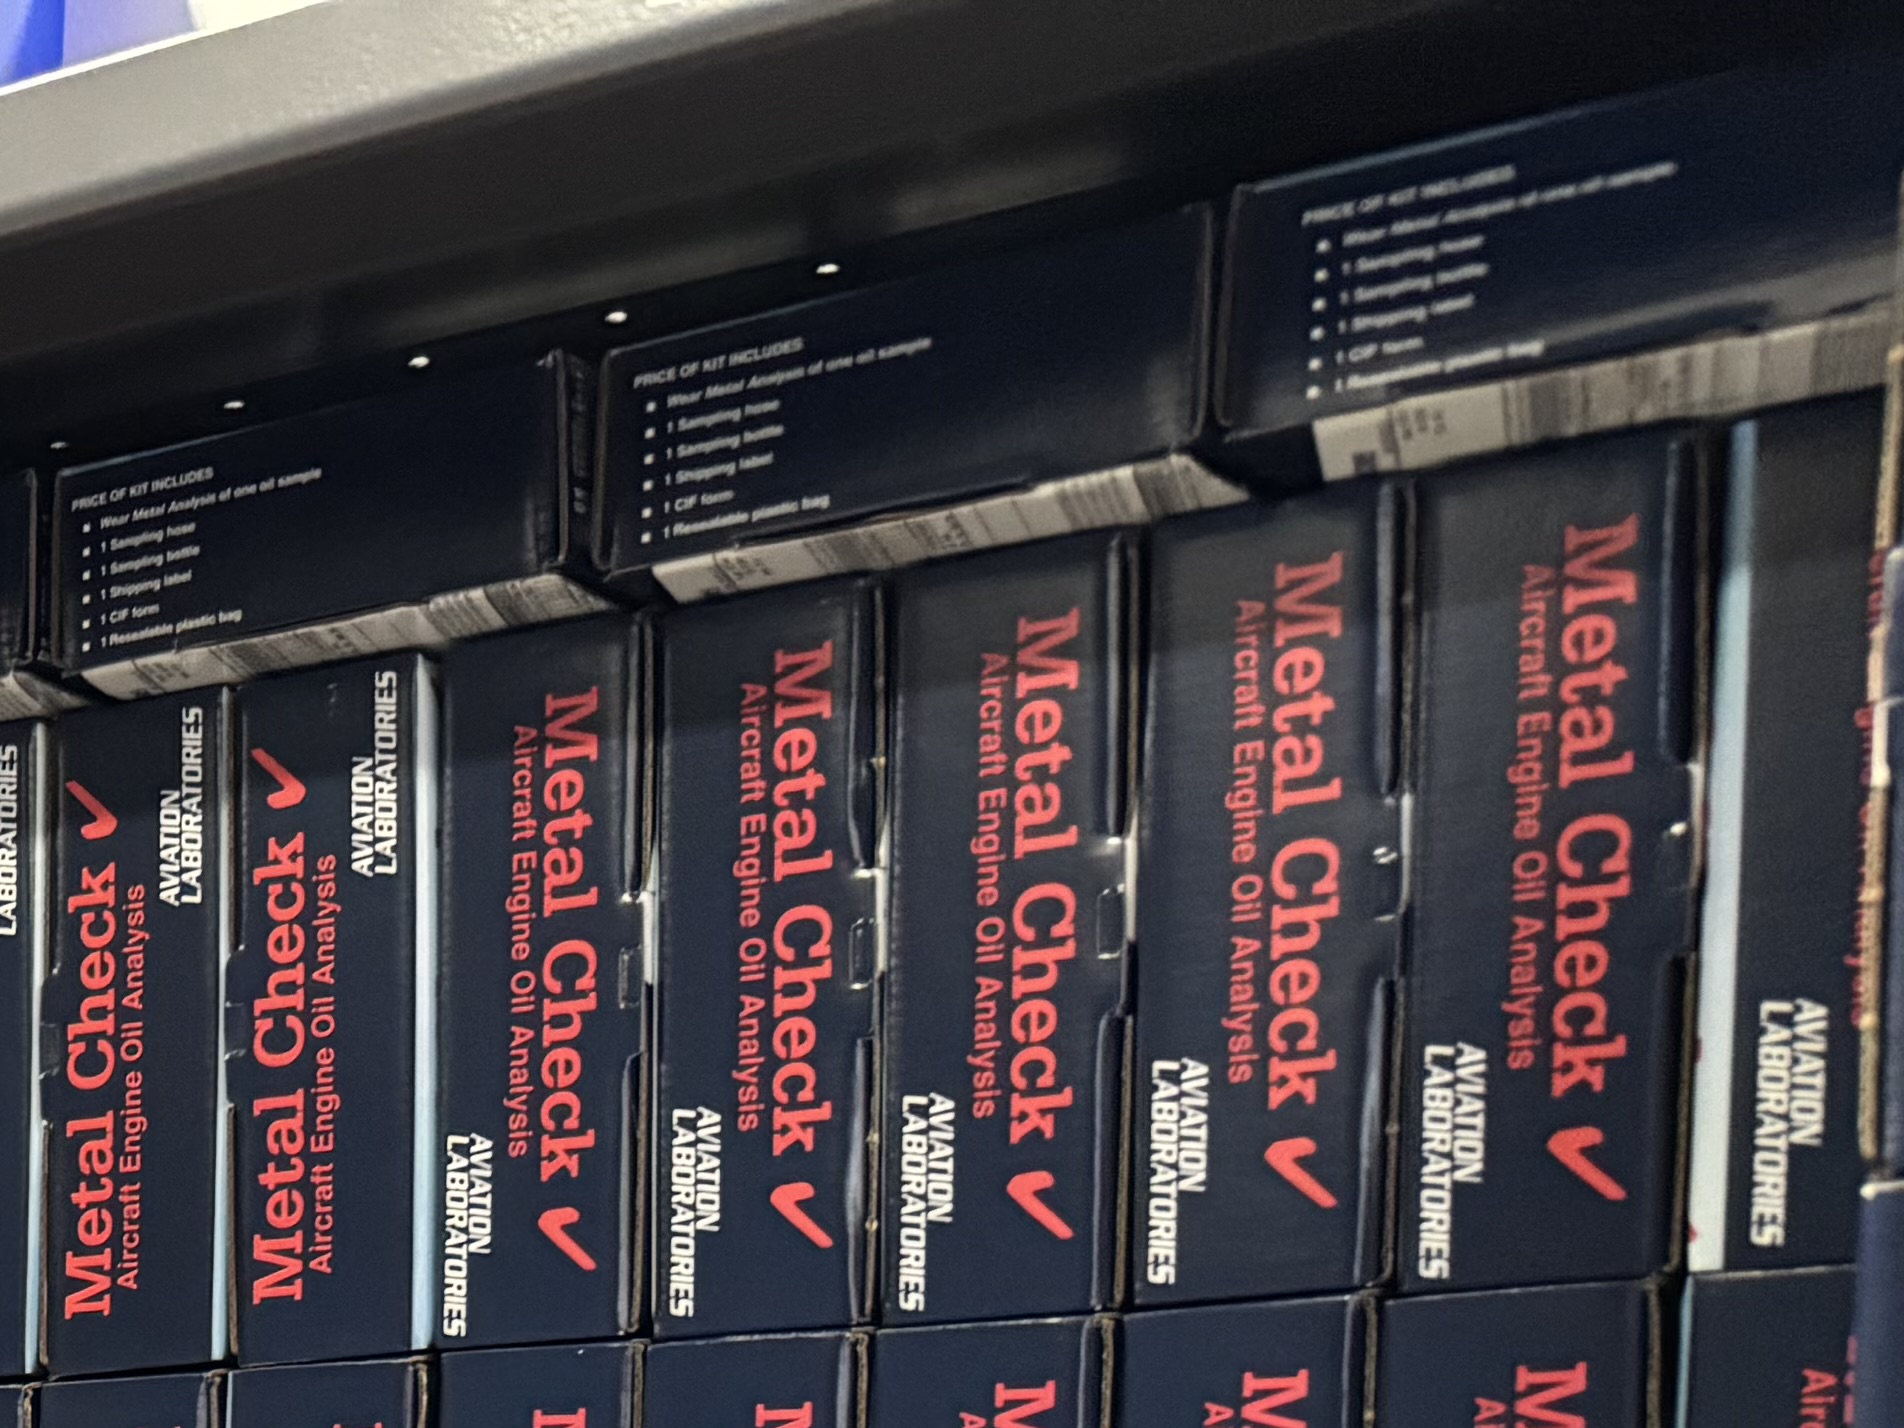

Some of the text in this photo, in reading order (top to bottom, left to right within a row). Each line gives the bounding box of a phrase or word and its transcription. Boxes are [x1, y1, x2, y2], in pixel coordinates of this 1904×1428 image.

[151, 466, 214, 493] INCLUDES
[1223, 603, 1266, 1083] Aircraft Engine Oil Analysis
[1269, 555, 1342, 1110] Metal Check
[1147, 1060, 1180, 1285] LABORATORIES
[1178, 1057, 1209, 1192] AVIATION
